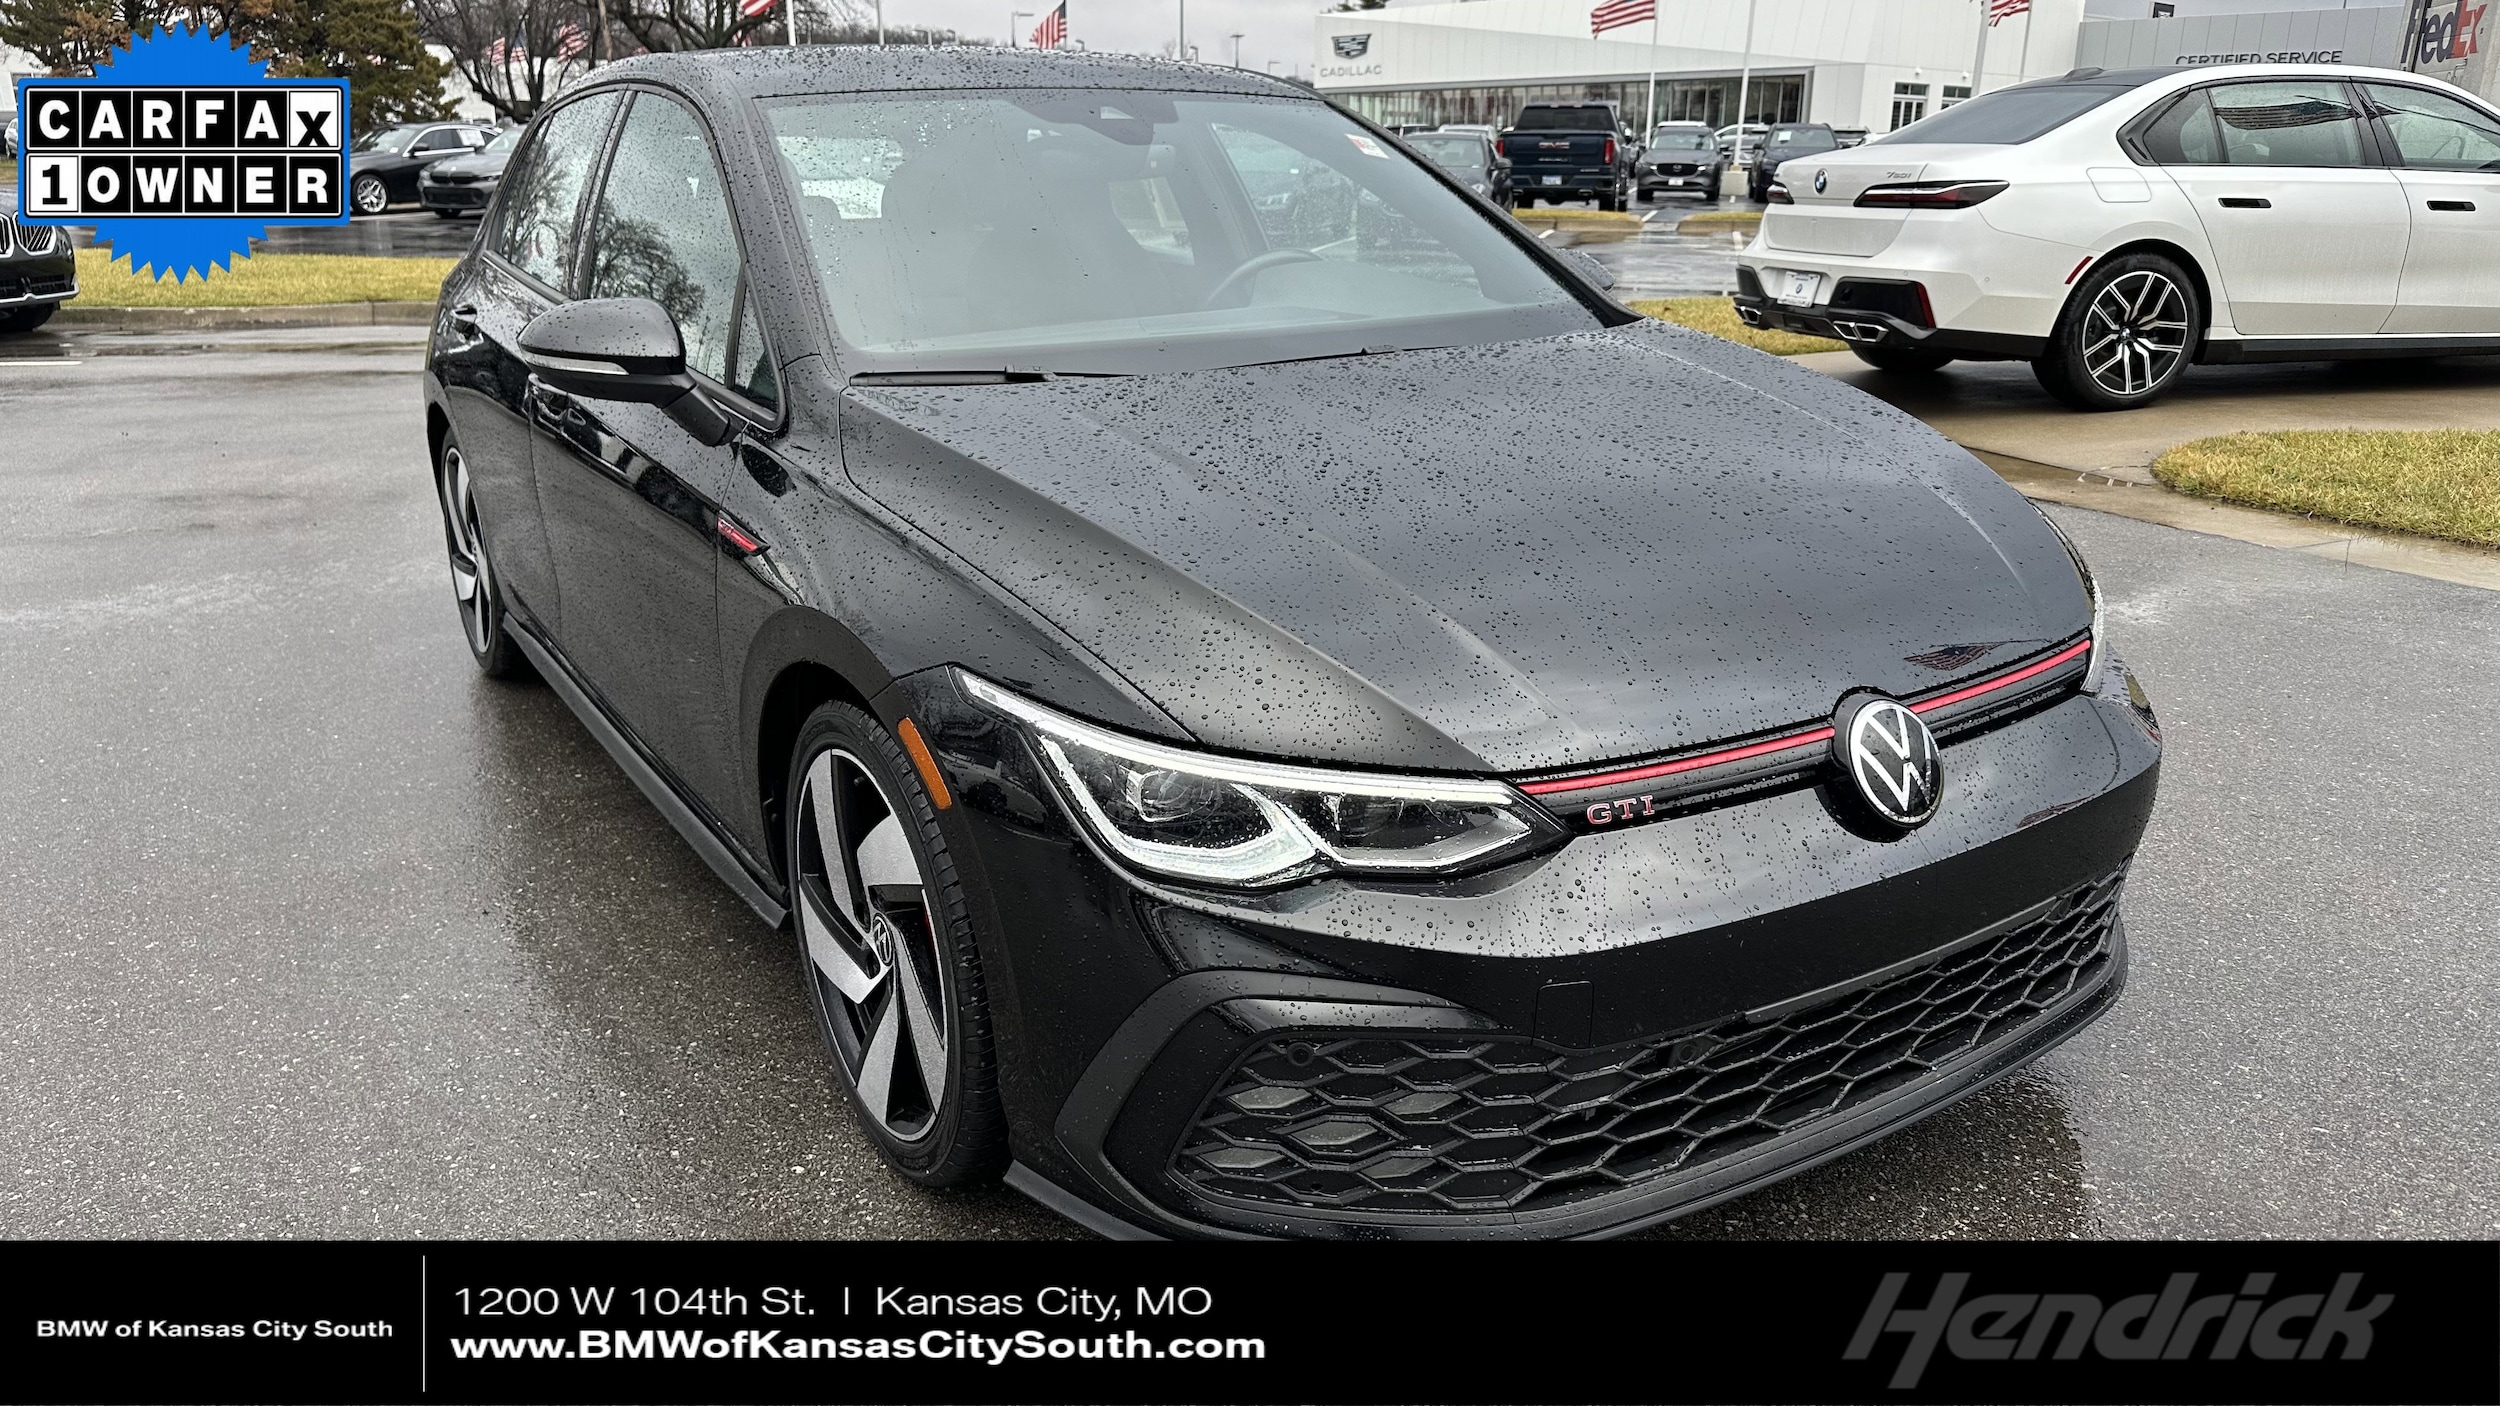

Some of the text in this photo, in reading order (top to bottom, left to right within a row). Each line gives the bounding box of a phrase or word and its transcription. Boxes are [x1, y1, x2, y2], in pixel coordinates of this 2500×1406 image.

[2265, 50, 2343, 64] SERVICE
[1319, 64, 1382, 77] CADILLAC
[1586, 794, 1656, 825] GTI
